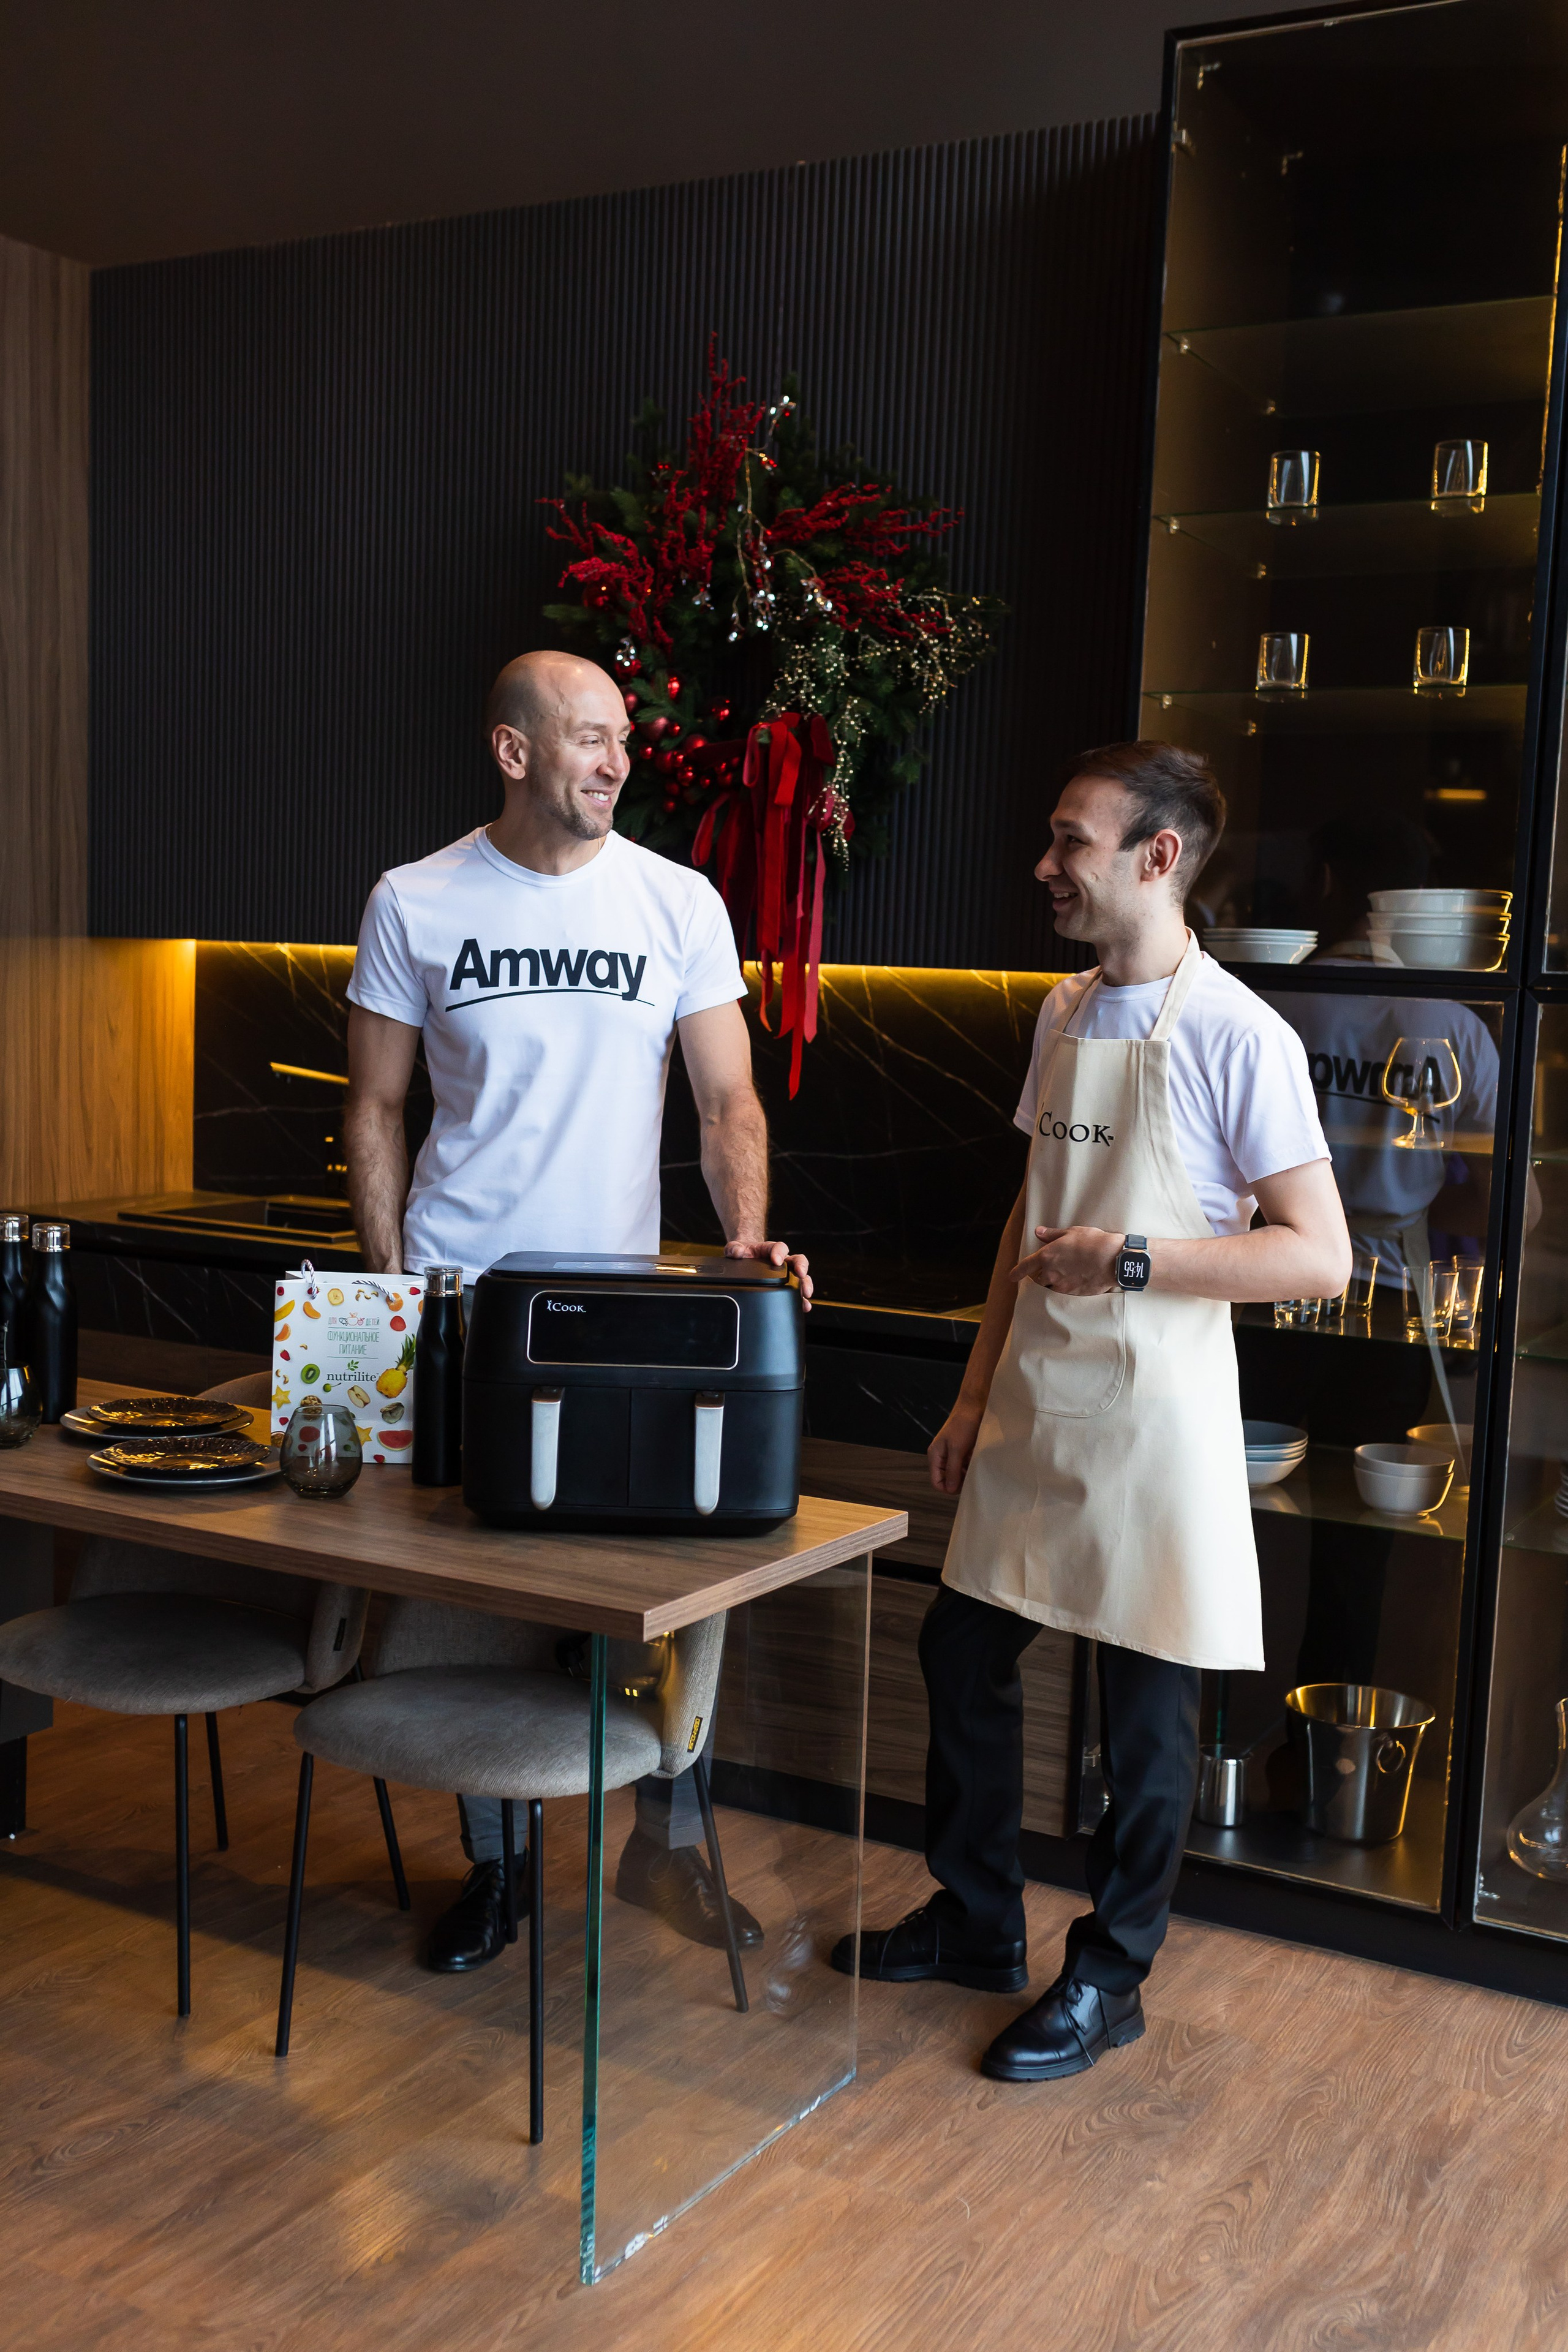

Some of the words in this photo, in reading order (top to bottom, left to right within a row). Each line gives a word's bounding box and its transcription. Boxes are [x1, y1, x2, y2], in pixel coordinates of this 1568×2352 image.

[450, 938, 647, 1001] Amway
[1123, 1261, 1144, 1278] 14:55
[327, 1330, 380, 1343] ФУНКЦИОНАЛЬНОЕ
[339, 1344, 368, 1355] ПИТАНИЕ
[326, 1371, 377, 1382] nutrilite
